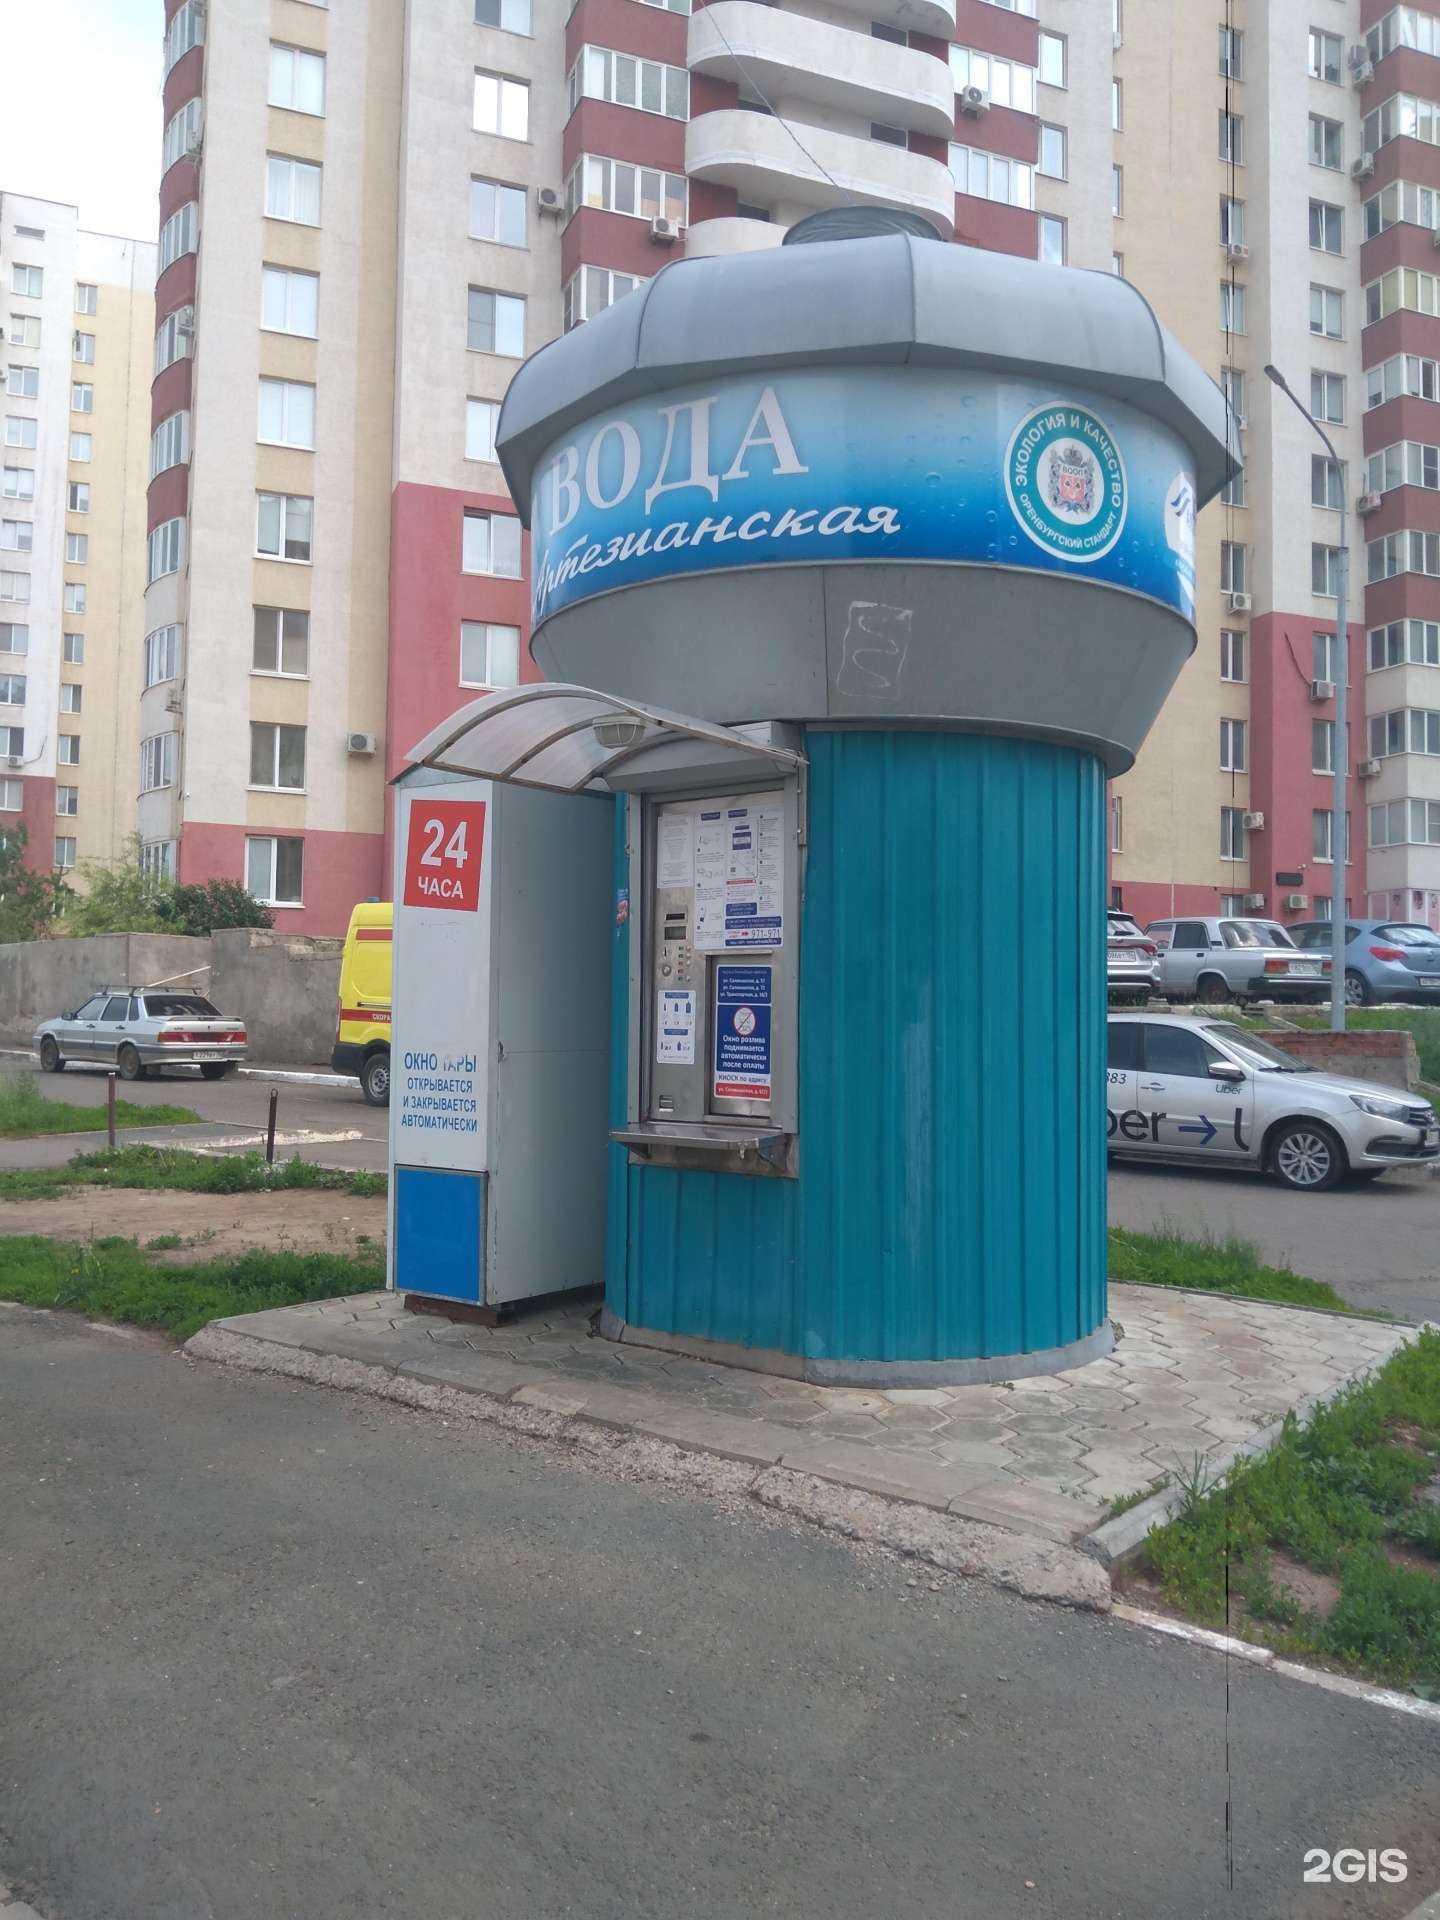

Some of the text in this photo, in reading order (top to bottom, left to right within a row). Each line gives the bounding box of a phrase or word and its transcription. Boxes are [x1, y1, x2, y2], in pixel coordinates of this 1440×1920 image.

[550, 386, 810, 535] ВОДА
[1015, 412, 1121, 508] ЭКОЛОГИЯ И КАЧЕСТВО
[1020, 494, 1117, 549] ОРЕНБУРГСКИЙ СТАНДАРТ
[420, 818, 468, 868] 24
[417, 875, 464, 899] ЧАСА
[404, 1052, 438, 1071] ОКНО
[407, 1077, 473, 1093] ОТКРЫВАЕТСЯ
[1215, 1084, 1242, 1095] Uber
[403, 1095, 477, 1112] И ЗАКРЫВАЕТСЯ
[401, 1114, 478, 1132] АВТОМАТИЧЕСКИ
